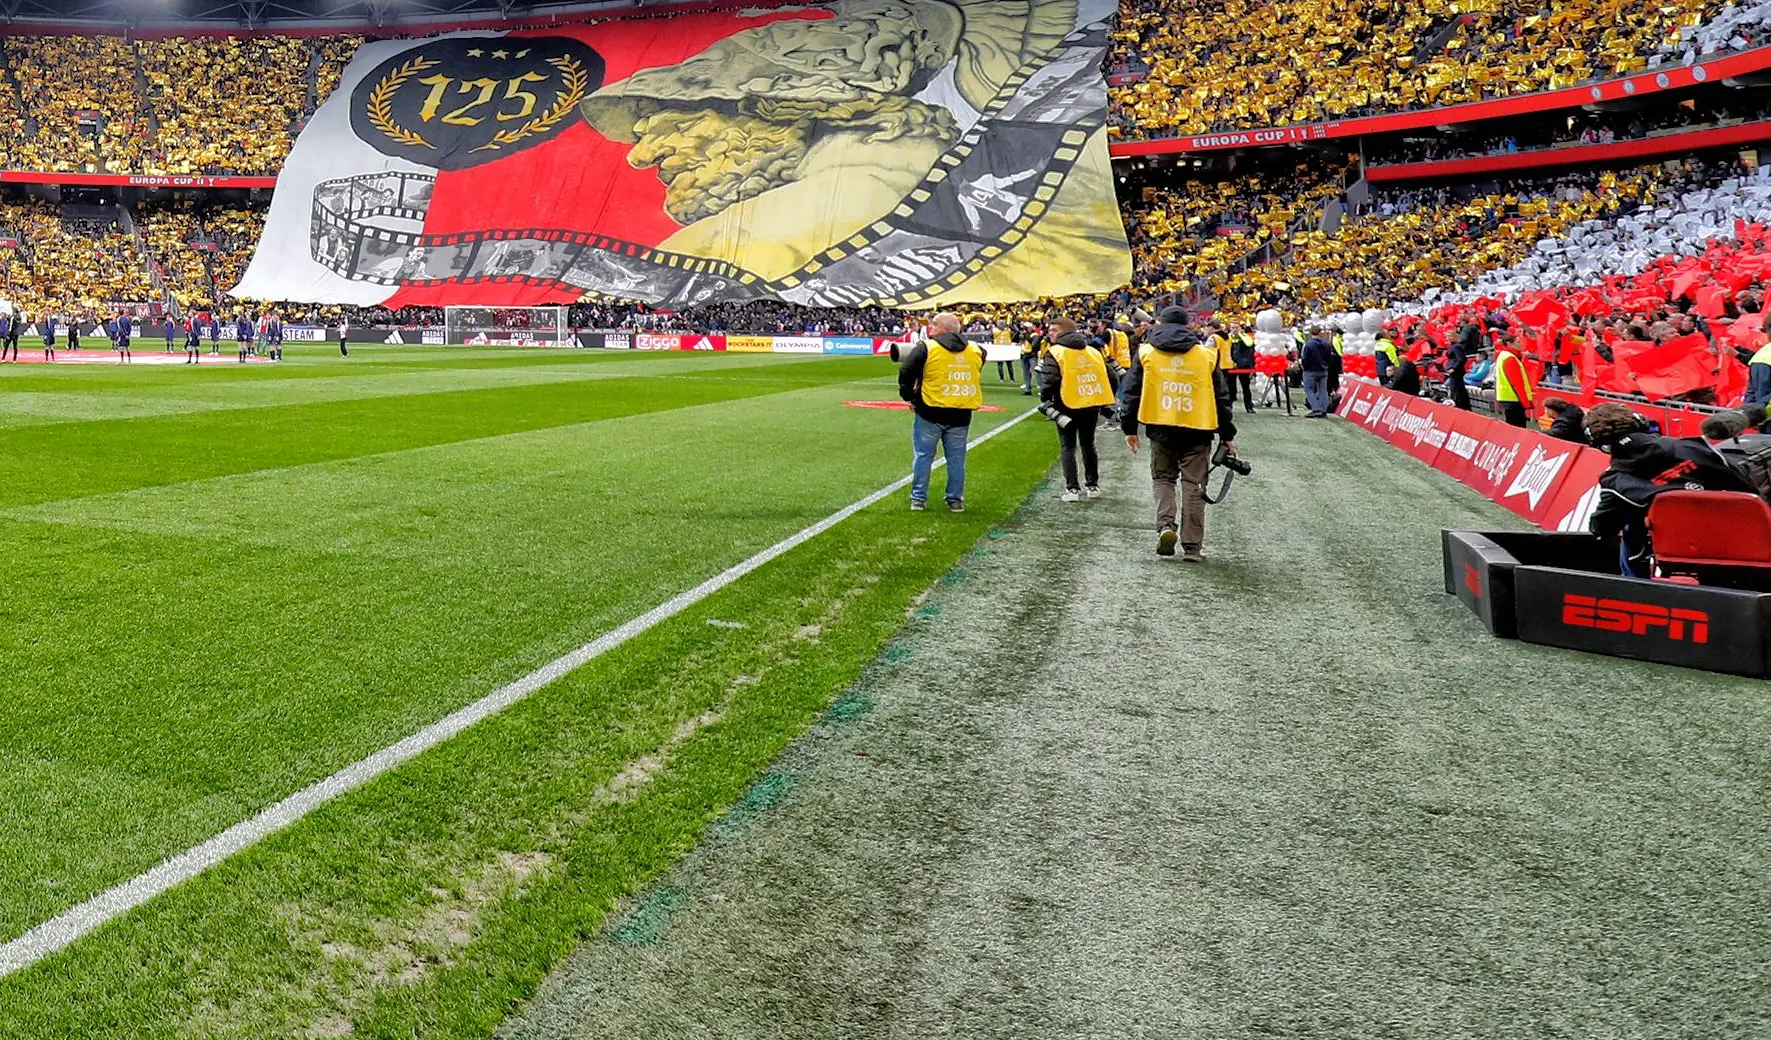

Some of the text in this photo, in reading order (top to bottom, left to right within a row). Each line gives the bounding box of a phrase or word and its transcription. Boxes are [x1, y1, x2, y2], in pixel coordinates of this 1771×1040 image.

[417, 71, 552, 126] 125
[1192, 135, 1250, 148] EUROPA
[1254, 130, 1285, 142] CUP
[948, 372, 972, 381] FOTO
[1077, 373, 1097, 383] FOTO
[1078, 385, 1103, 396] 034
[1162, 380, 1192, 394] FOTO
[1160, 395, 1194, 412] 013
[1561, 593, 1709, 644] ESPN
